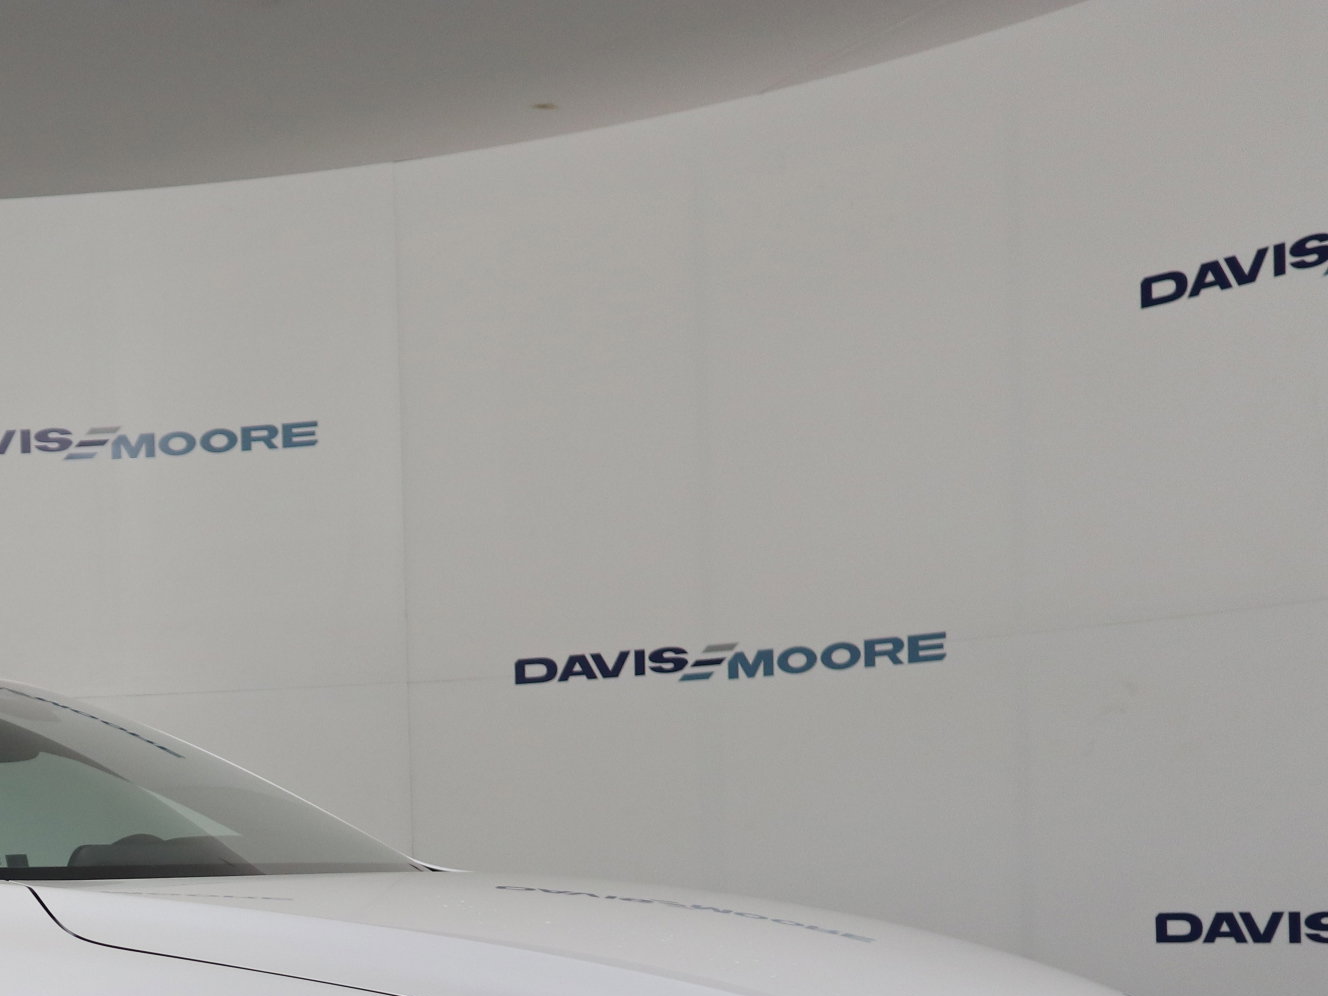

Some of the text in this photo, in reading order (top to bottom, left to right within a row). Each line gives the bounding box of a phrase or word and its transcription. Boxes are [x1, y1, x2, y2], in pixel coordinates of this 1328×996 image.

[110, 420, 319, 460] MOORE
[514, 631, 947, 685] DAVIS MOORE
